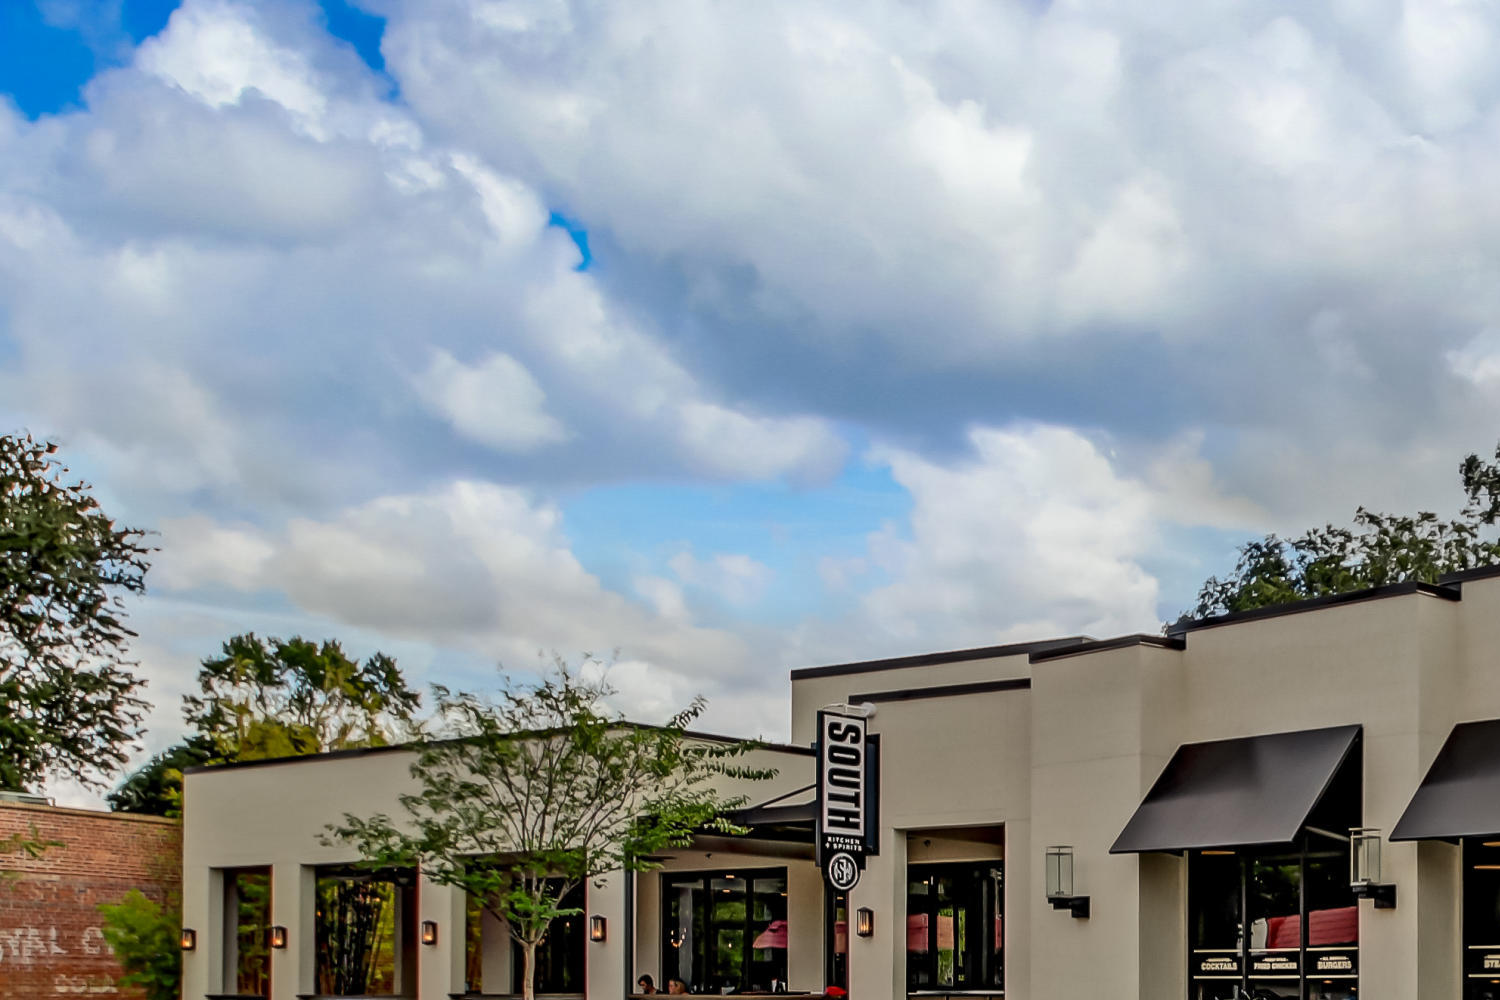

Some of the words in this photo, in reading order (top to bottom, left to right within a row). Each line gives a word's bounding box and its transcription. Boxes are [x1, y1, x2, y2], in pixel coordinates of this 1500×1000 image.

[827, 721, 861, 830] SOUTH
[827, 836, 860, 845] KITCHEN
[1201, 962, 1238, 971] COCKTAILS
[1317, 960, 1352, 970] BURGERS
